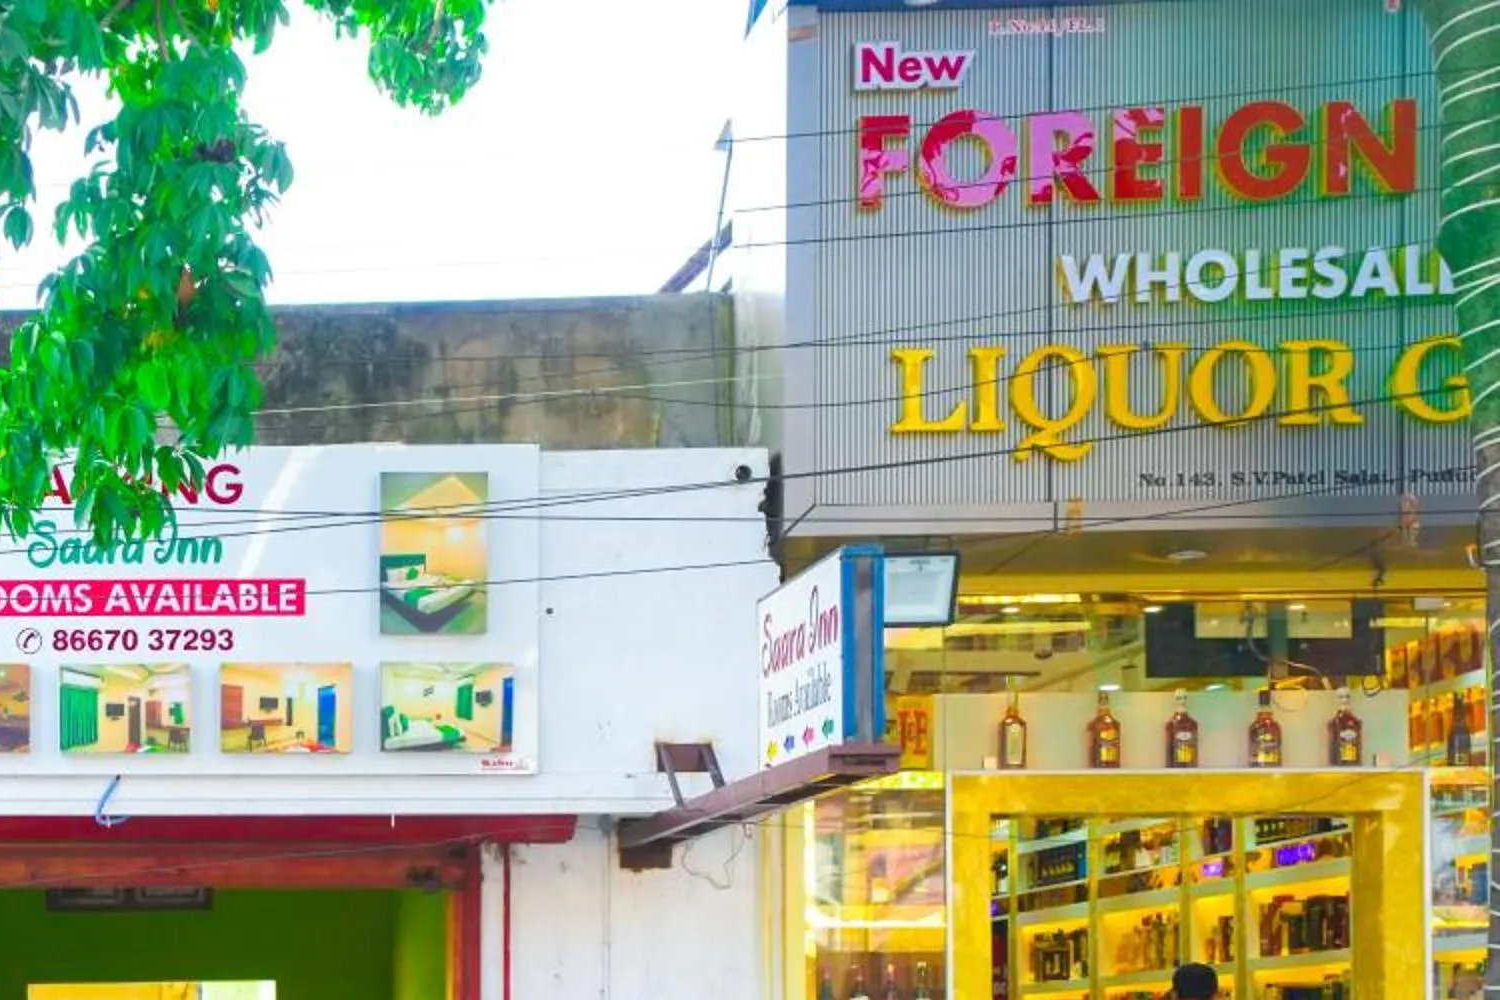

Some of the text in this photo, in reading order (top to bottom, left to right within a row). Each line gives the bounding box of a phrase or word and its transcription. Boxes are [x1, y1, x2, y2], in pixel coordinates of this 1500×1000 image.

[861, 46, 966, 84] New
[858, 98, 1417, 208] FOREIGN
[890, 338, 1362, 461] LIQUOR
[104, 583, 298, 613] AVAILABLE
[808, 584, 839, 653] Inn
[52, 629, 234, 651] 86670 37293
